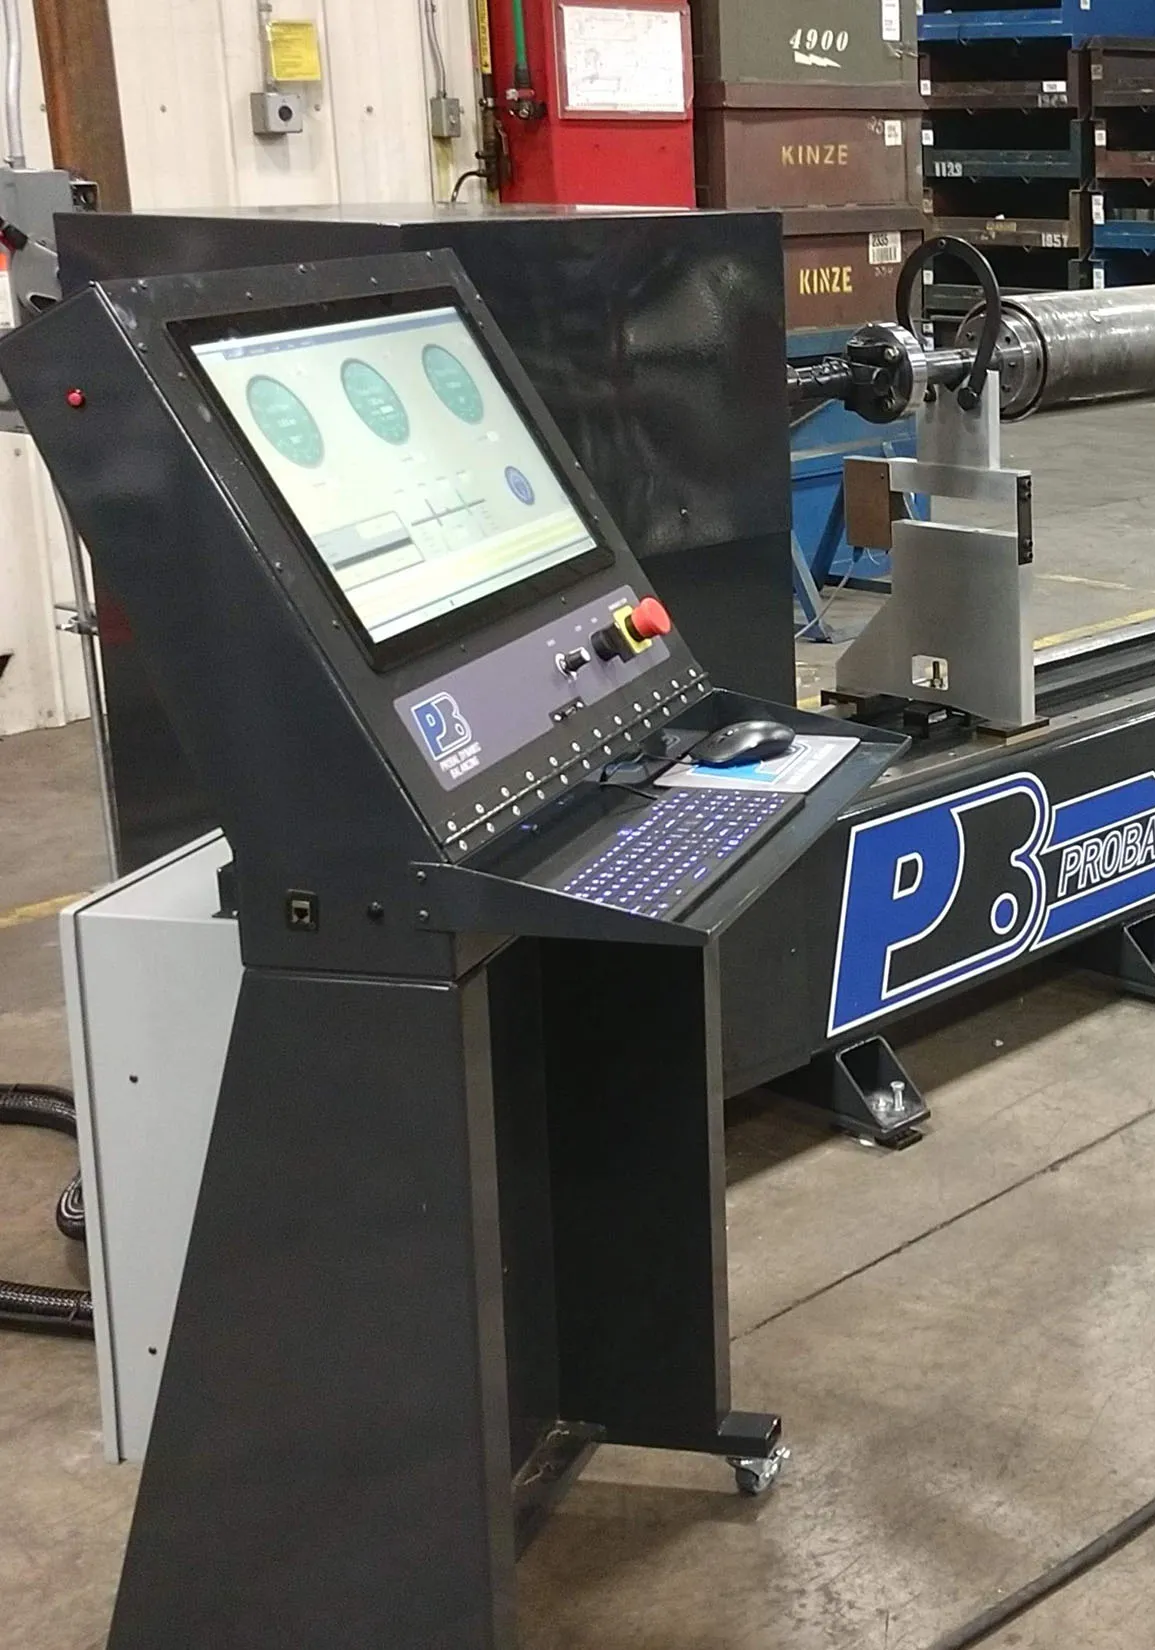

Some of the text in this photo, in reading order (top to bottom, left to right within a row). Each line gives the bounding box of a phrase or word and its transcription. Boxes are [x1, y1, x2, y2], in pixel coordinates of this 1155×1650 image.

[789, 28, 849, 52] 4900
[781, 144, 849, 166] KINZE
[799, 265, 853, 295] KINZE
